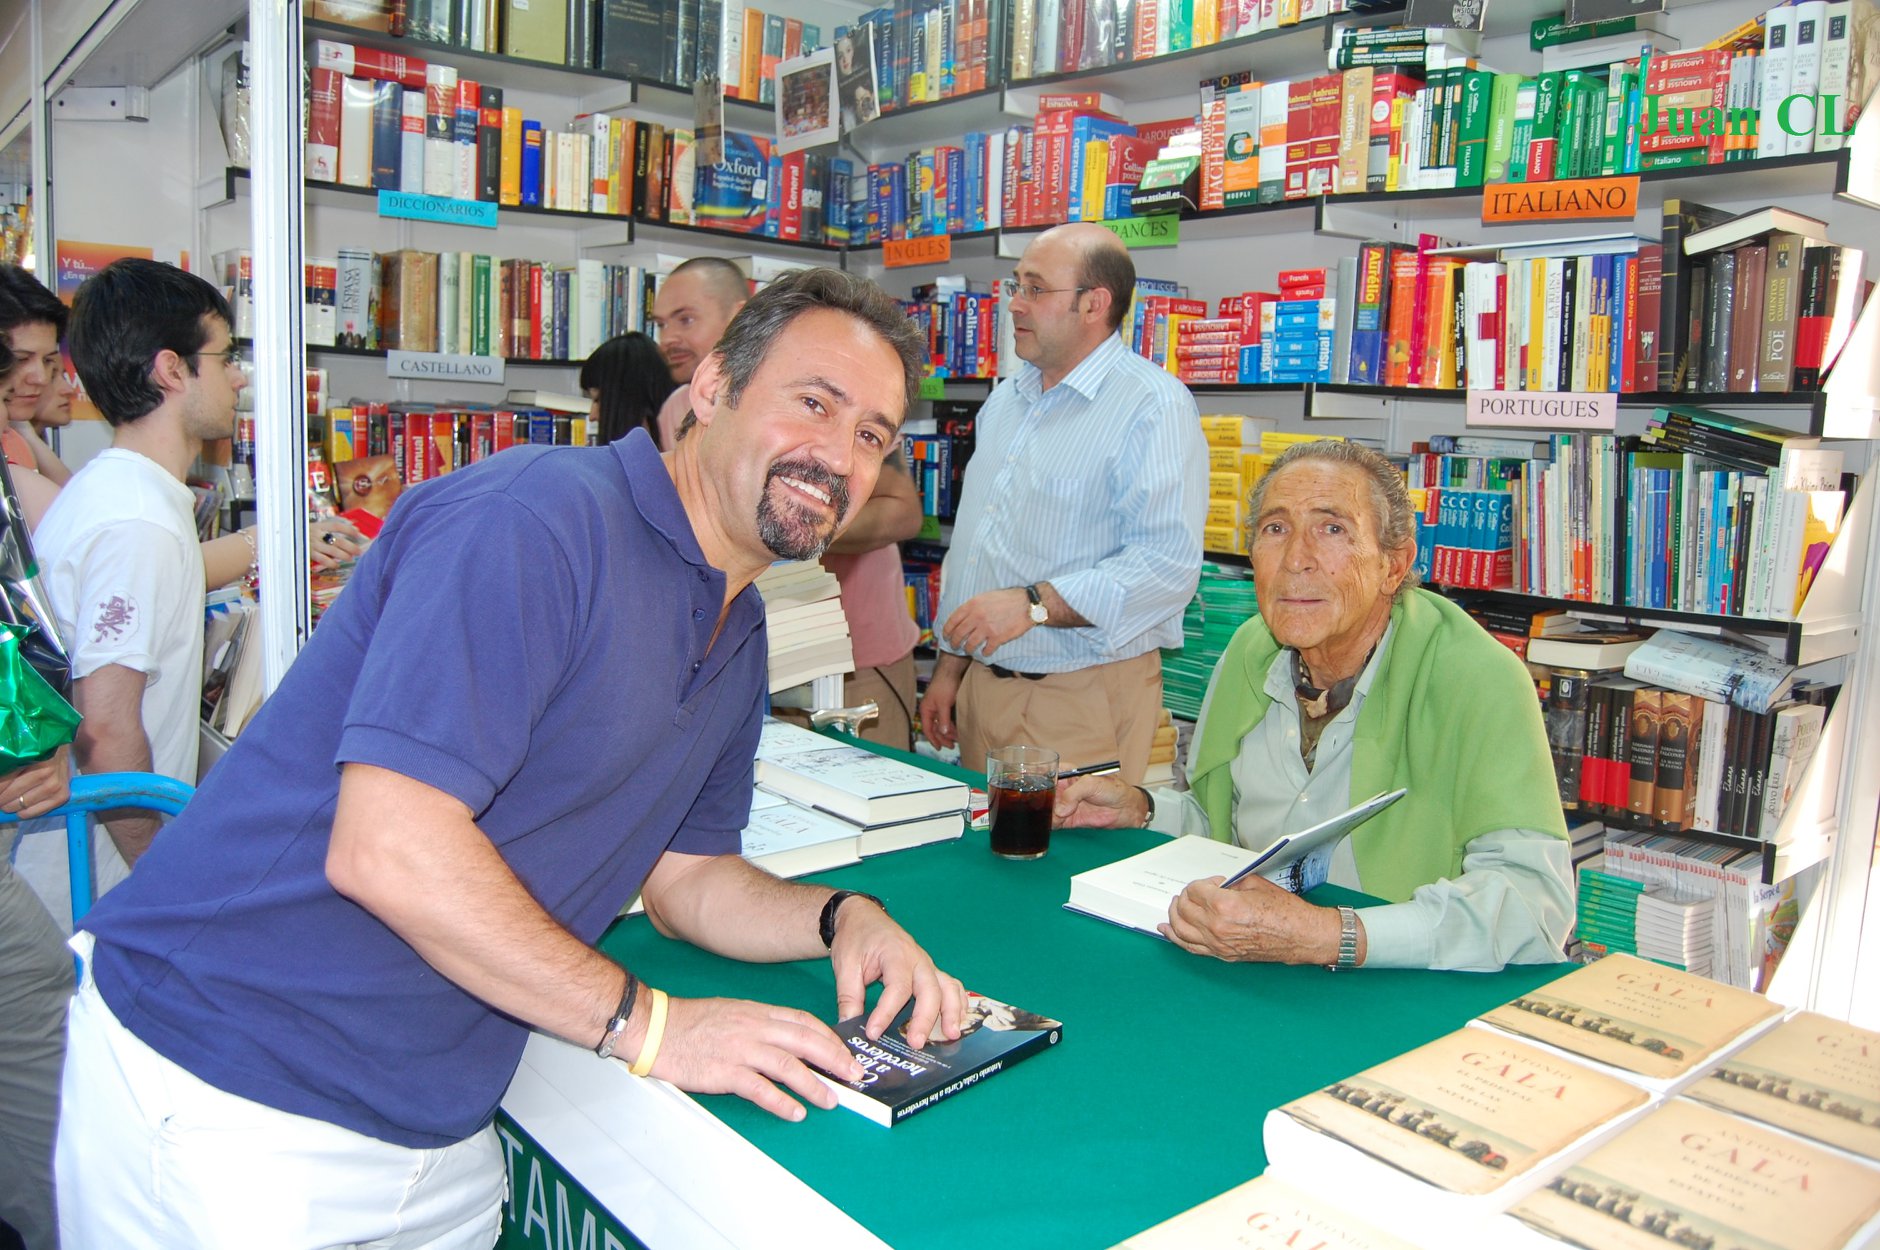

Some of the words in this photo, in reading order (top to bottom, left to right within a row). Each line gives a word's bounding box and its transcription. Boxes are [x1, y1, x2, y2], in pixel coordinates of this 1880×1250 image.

[881, 21, 891, 89] Dictionary
[912, 27, 924, 72] Spanis
[1343, 95, 1354, 151] Maggiore
[1493, 118, 1504, 151] Italiano
[712, 158, 761, 178] Oxford
[1034, 138, 1043, 196] LAROUSSE
[1051, 136, 1063, 195] LAROUSSE
[1071, 138, 1081, 193] Avanzado
[1463, 145, 1471, 177] ITALIANO
[1534, 143, 1542, 174] ITALIANO
[1654, 156, 1681, 166] Italiano
[788, 165, 799, 210] General
[1492, 187, 1626, 215] ITALIANO
[388, 195, 485, 218] DICCIONARIOS
[1104, 220, 1168, 239] RANCES
[886, 239, 946, 262] INGLES
[342, 268, 353, 311] ESPASA
[1136, 282, 1176, 293] AROUSSE
[1366, 250, 1382, 303] Aurélio
[1547, 272, 1557, 303] REINA
[1547, 307, 1556, 319] LA
[1768, 279, 1778, 322] CUENTOS
[1778, 277, 1786, 322] COMPLETOS
[965, 297, 977, 346] Collins
[1771, 330, 1785, 360] POE
[400, 359, 492, 376] CASTELLANO
[1480, 397, 1599, 418] PORTUGUES
[412, 436, 424, 481] Manual
[1617, 973, 1712, 1008] GALA
[847, 1036, 927, 1077] herederos
[1462, 1052, 1567, 1100] GALA
[897, 1095, 929, 1118] herederos
[1681, 1133, 1808, 1191] GALA
